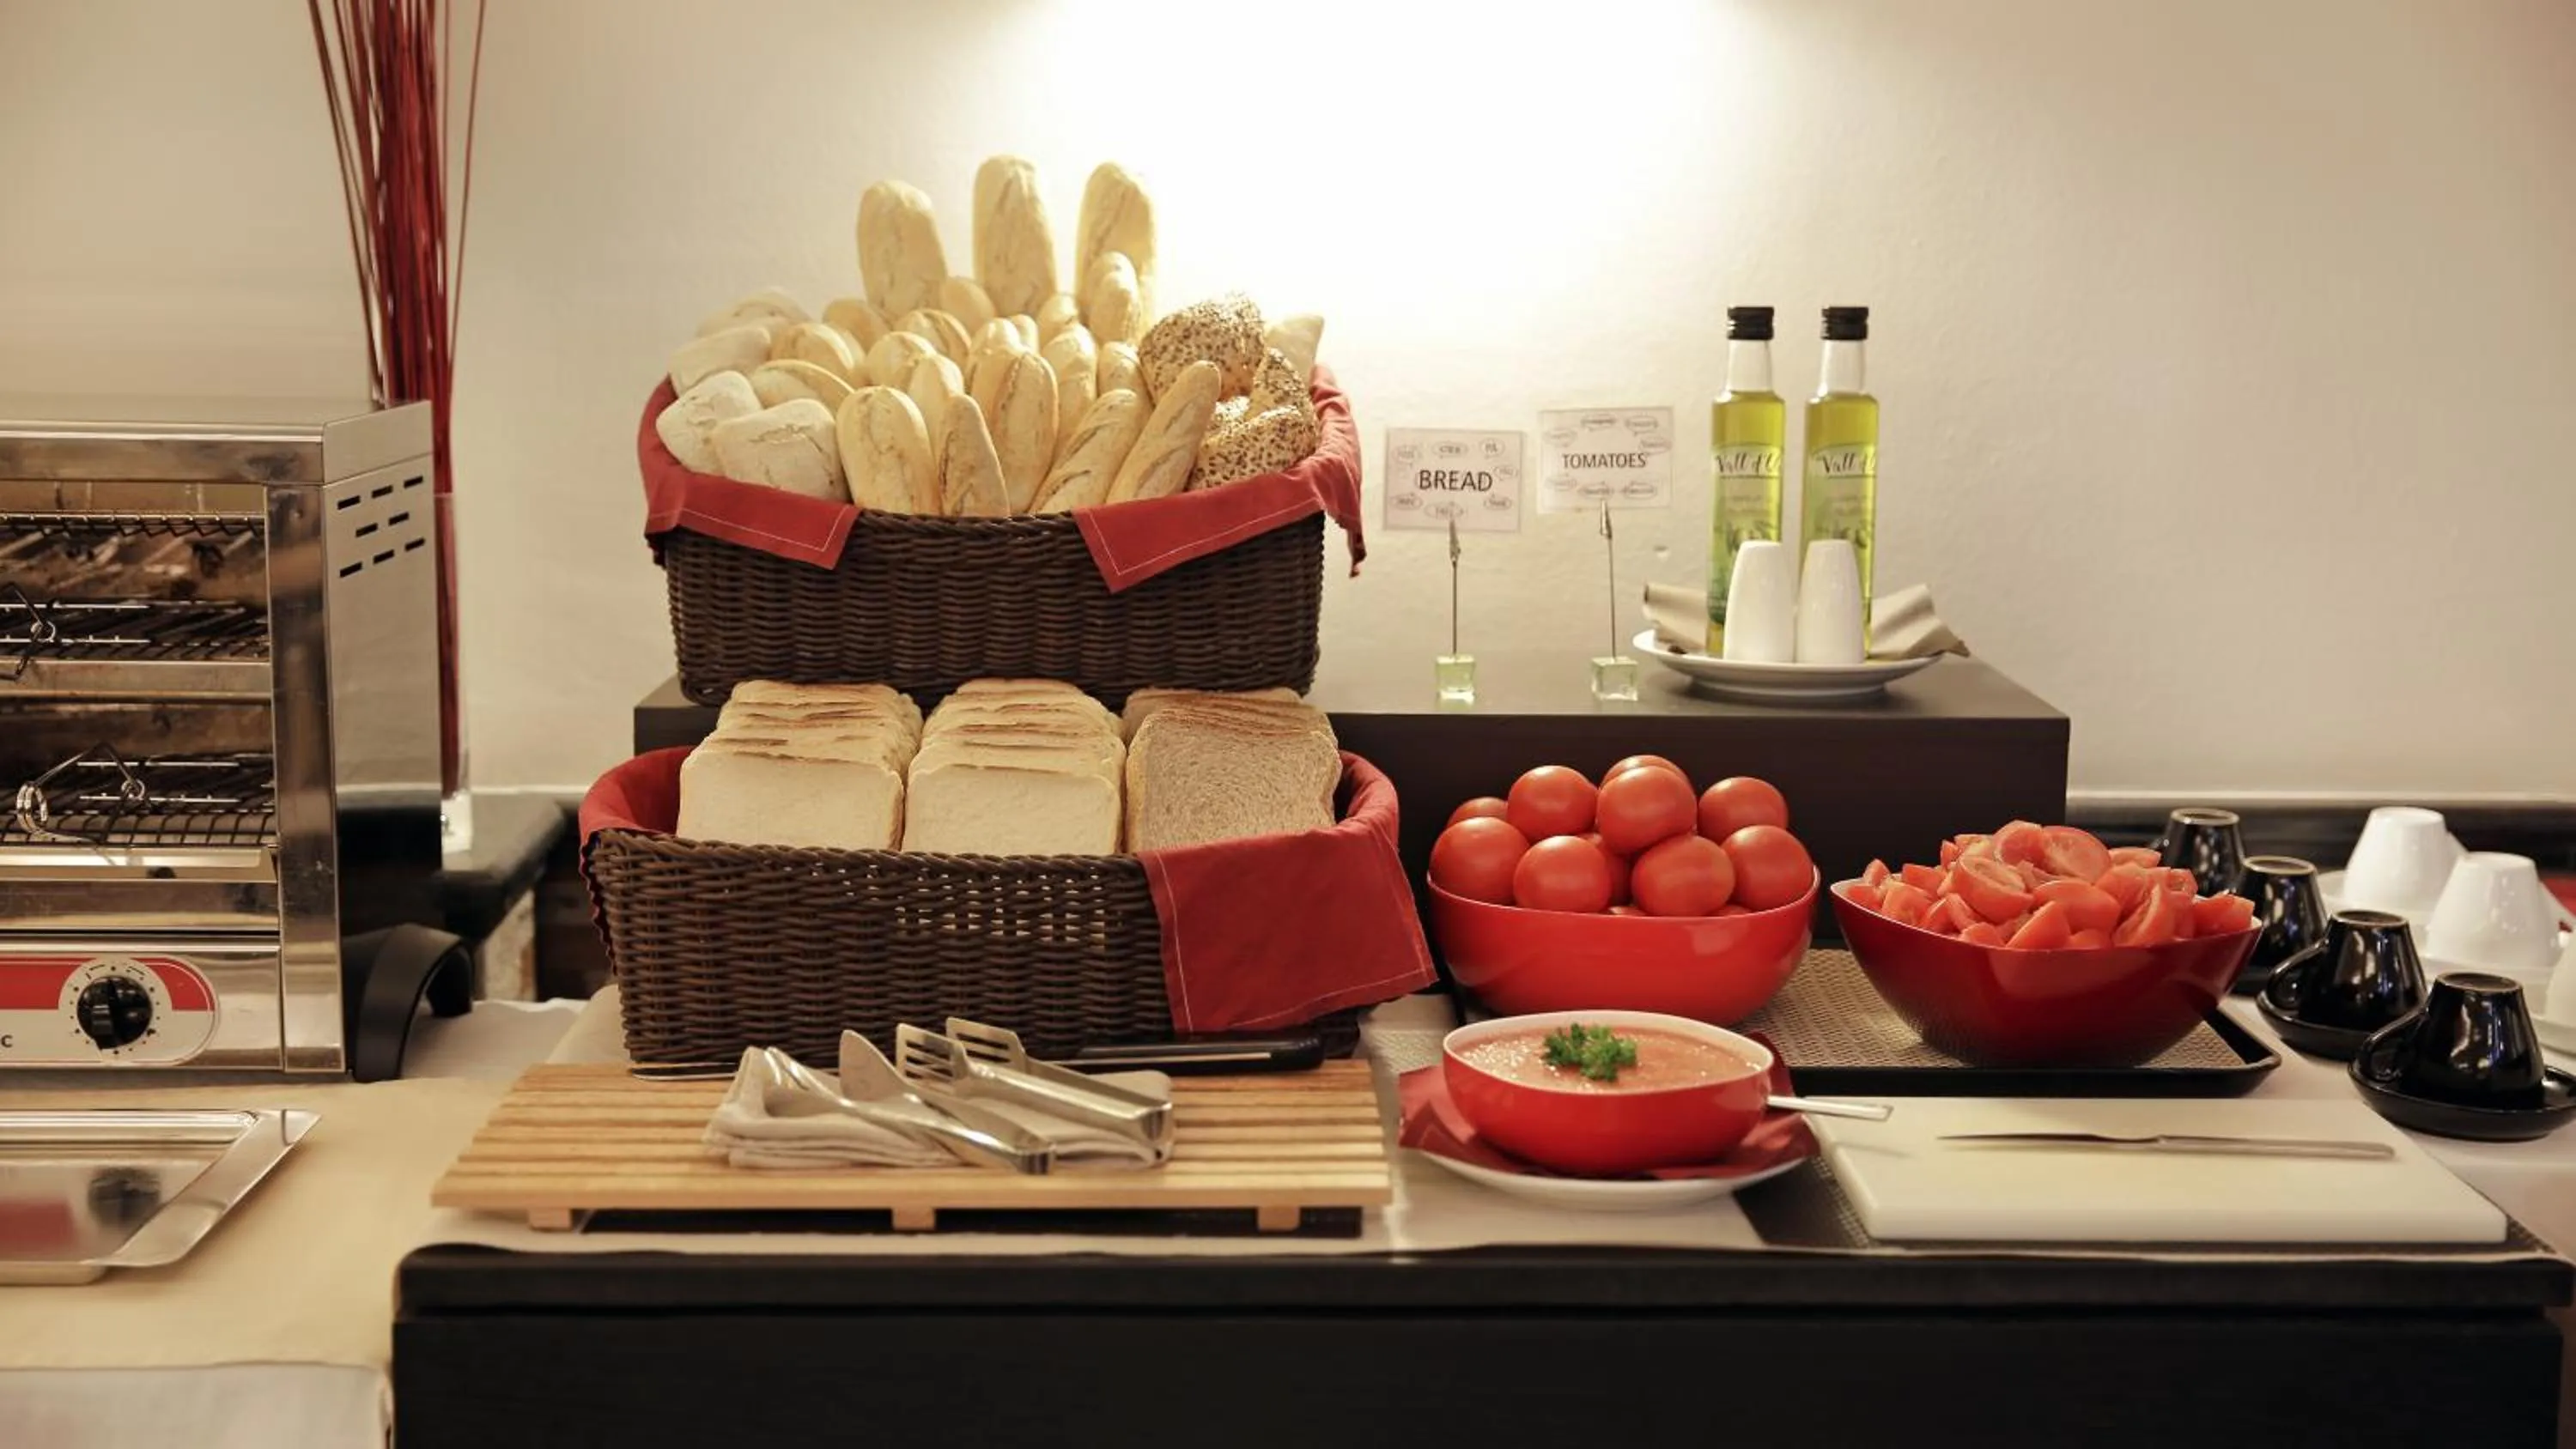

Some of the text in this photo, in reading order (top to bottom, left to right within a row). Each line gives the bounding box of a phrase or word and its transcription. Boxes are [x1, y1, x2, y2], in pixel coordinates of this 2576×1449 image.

[1563, 453, 1646, 469] TOMATOES
[1715, 452, 1747, 472] Vall
[1818, 452, 1856, 473] Vall
[1419, 470, 1492, 491] BREAD
